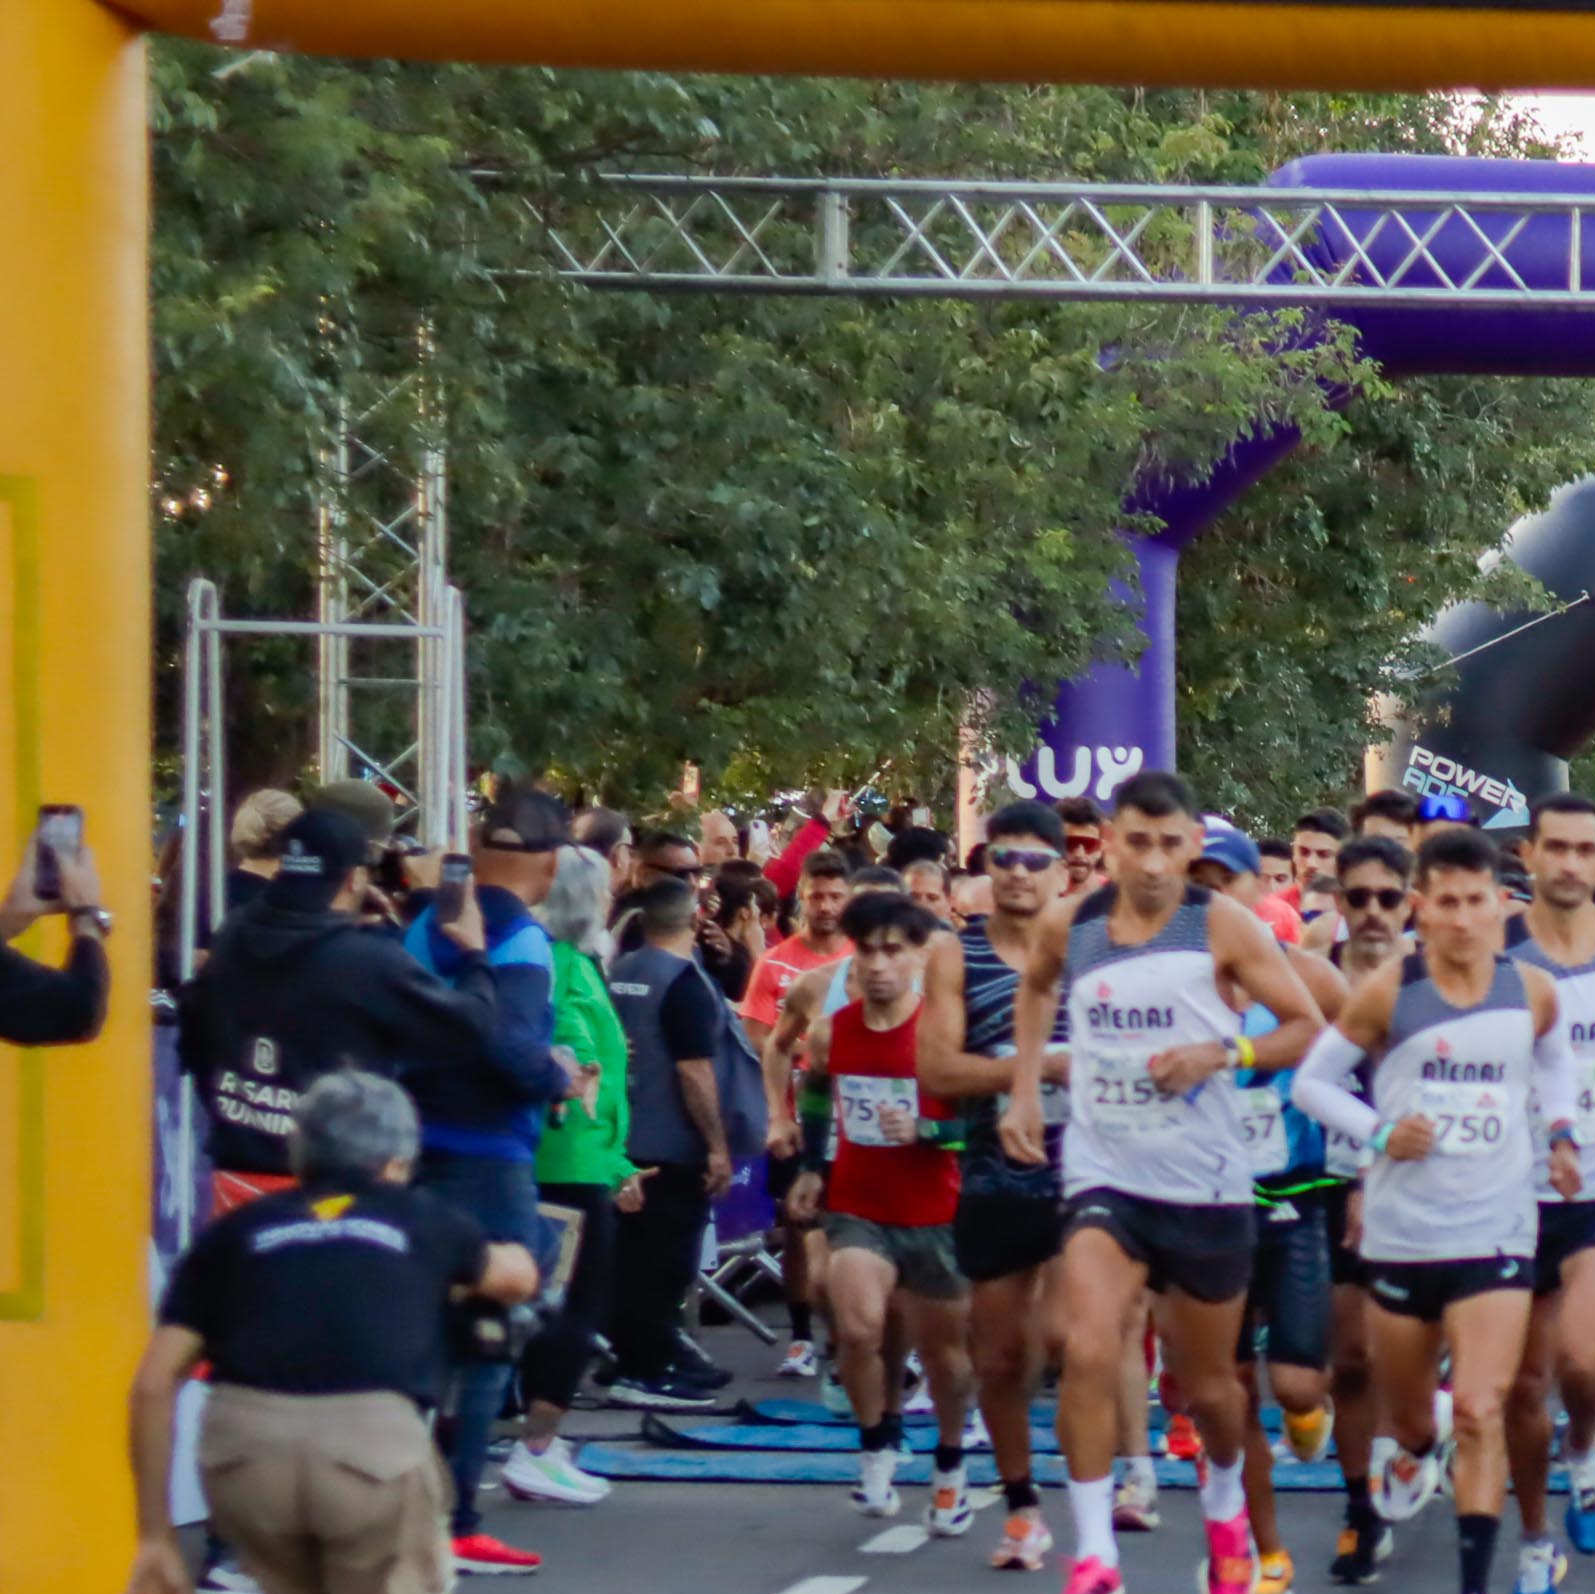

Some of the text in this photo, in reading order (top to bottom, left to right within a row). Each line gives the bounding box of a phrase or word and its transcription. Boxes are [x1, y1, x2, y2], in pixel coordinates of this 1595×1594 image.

[1409, 745, 1527, 814] POWER
[1088, 1003, 1174, 1028] ATENAS
[1421, 1057, 1505, 1083] ATENAS
[1241, 1114, 1276, 1142] 57
[1436, 1114, 1501, 1144] 750
